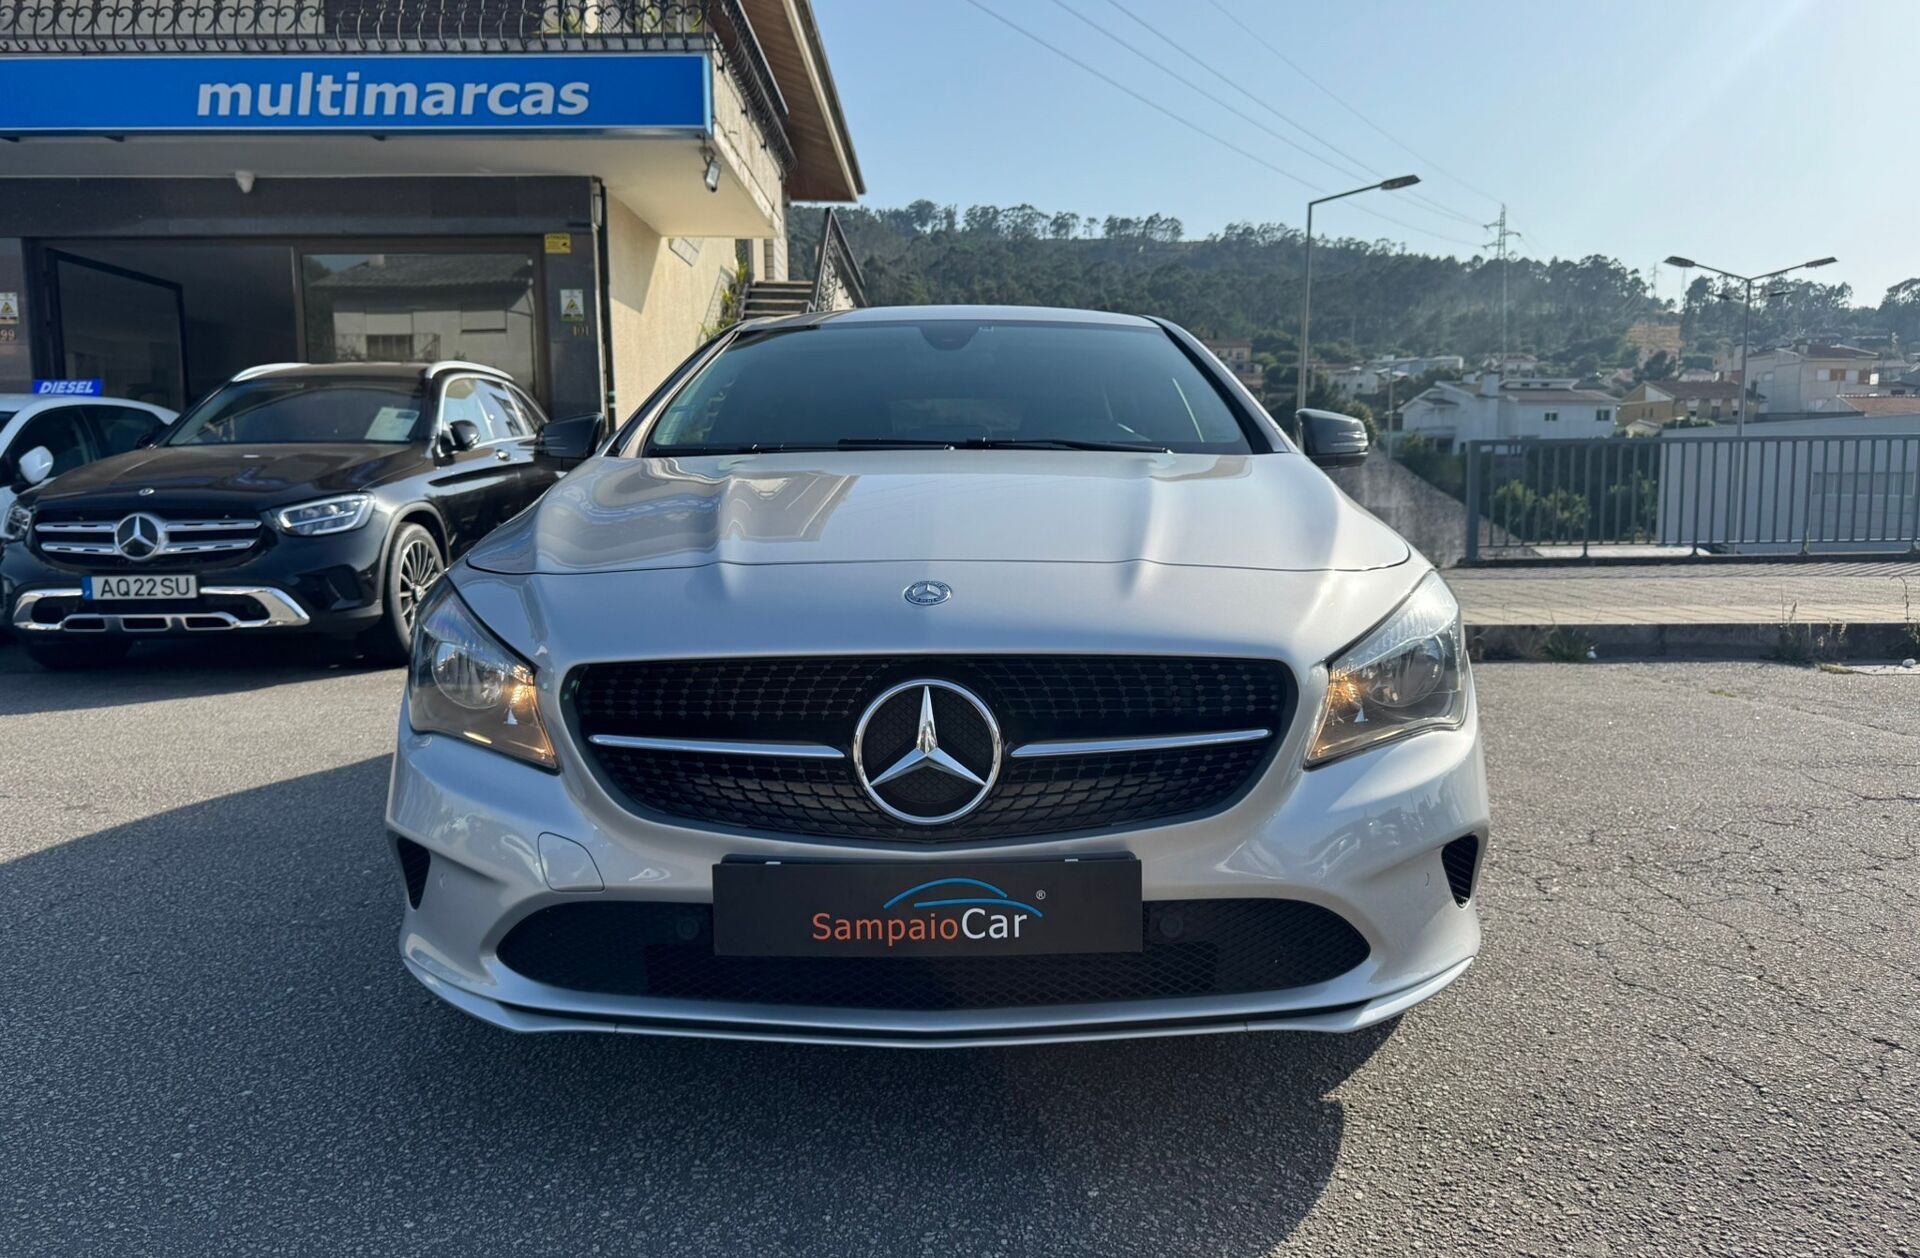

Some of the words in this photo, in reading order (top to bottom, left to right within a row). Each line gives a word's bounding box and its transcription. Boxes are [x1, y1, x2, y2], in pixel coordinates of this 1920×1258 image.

[197, 72, 590, 116] multimarcas
[39, 380, 94, 394] DIESEL
[812, 908, 1027, 946] SampaioCar
